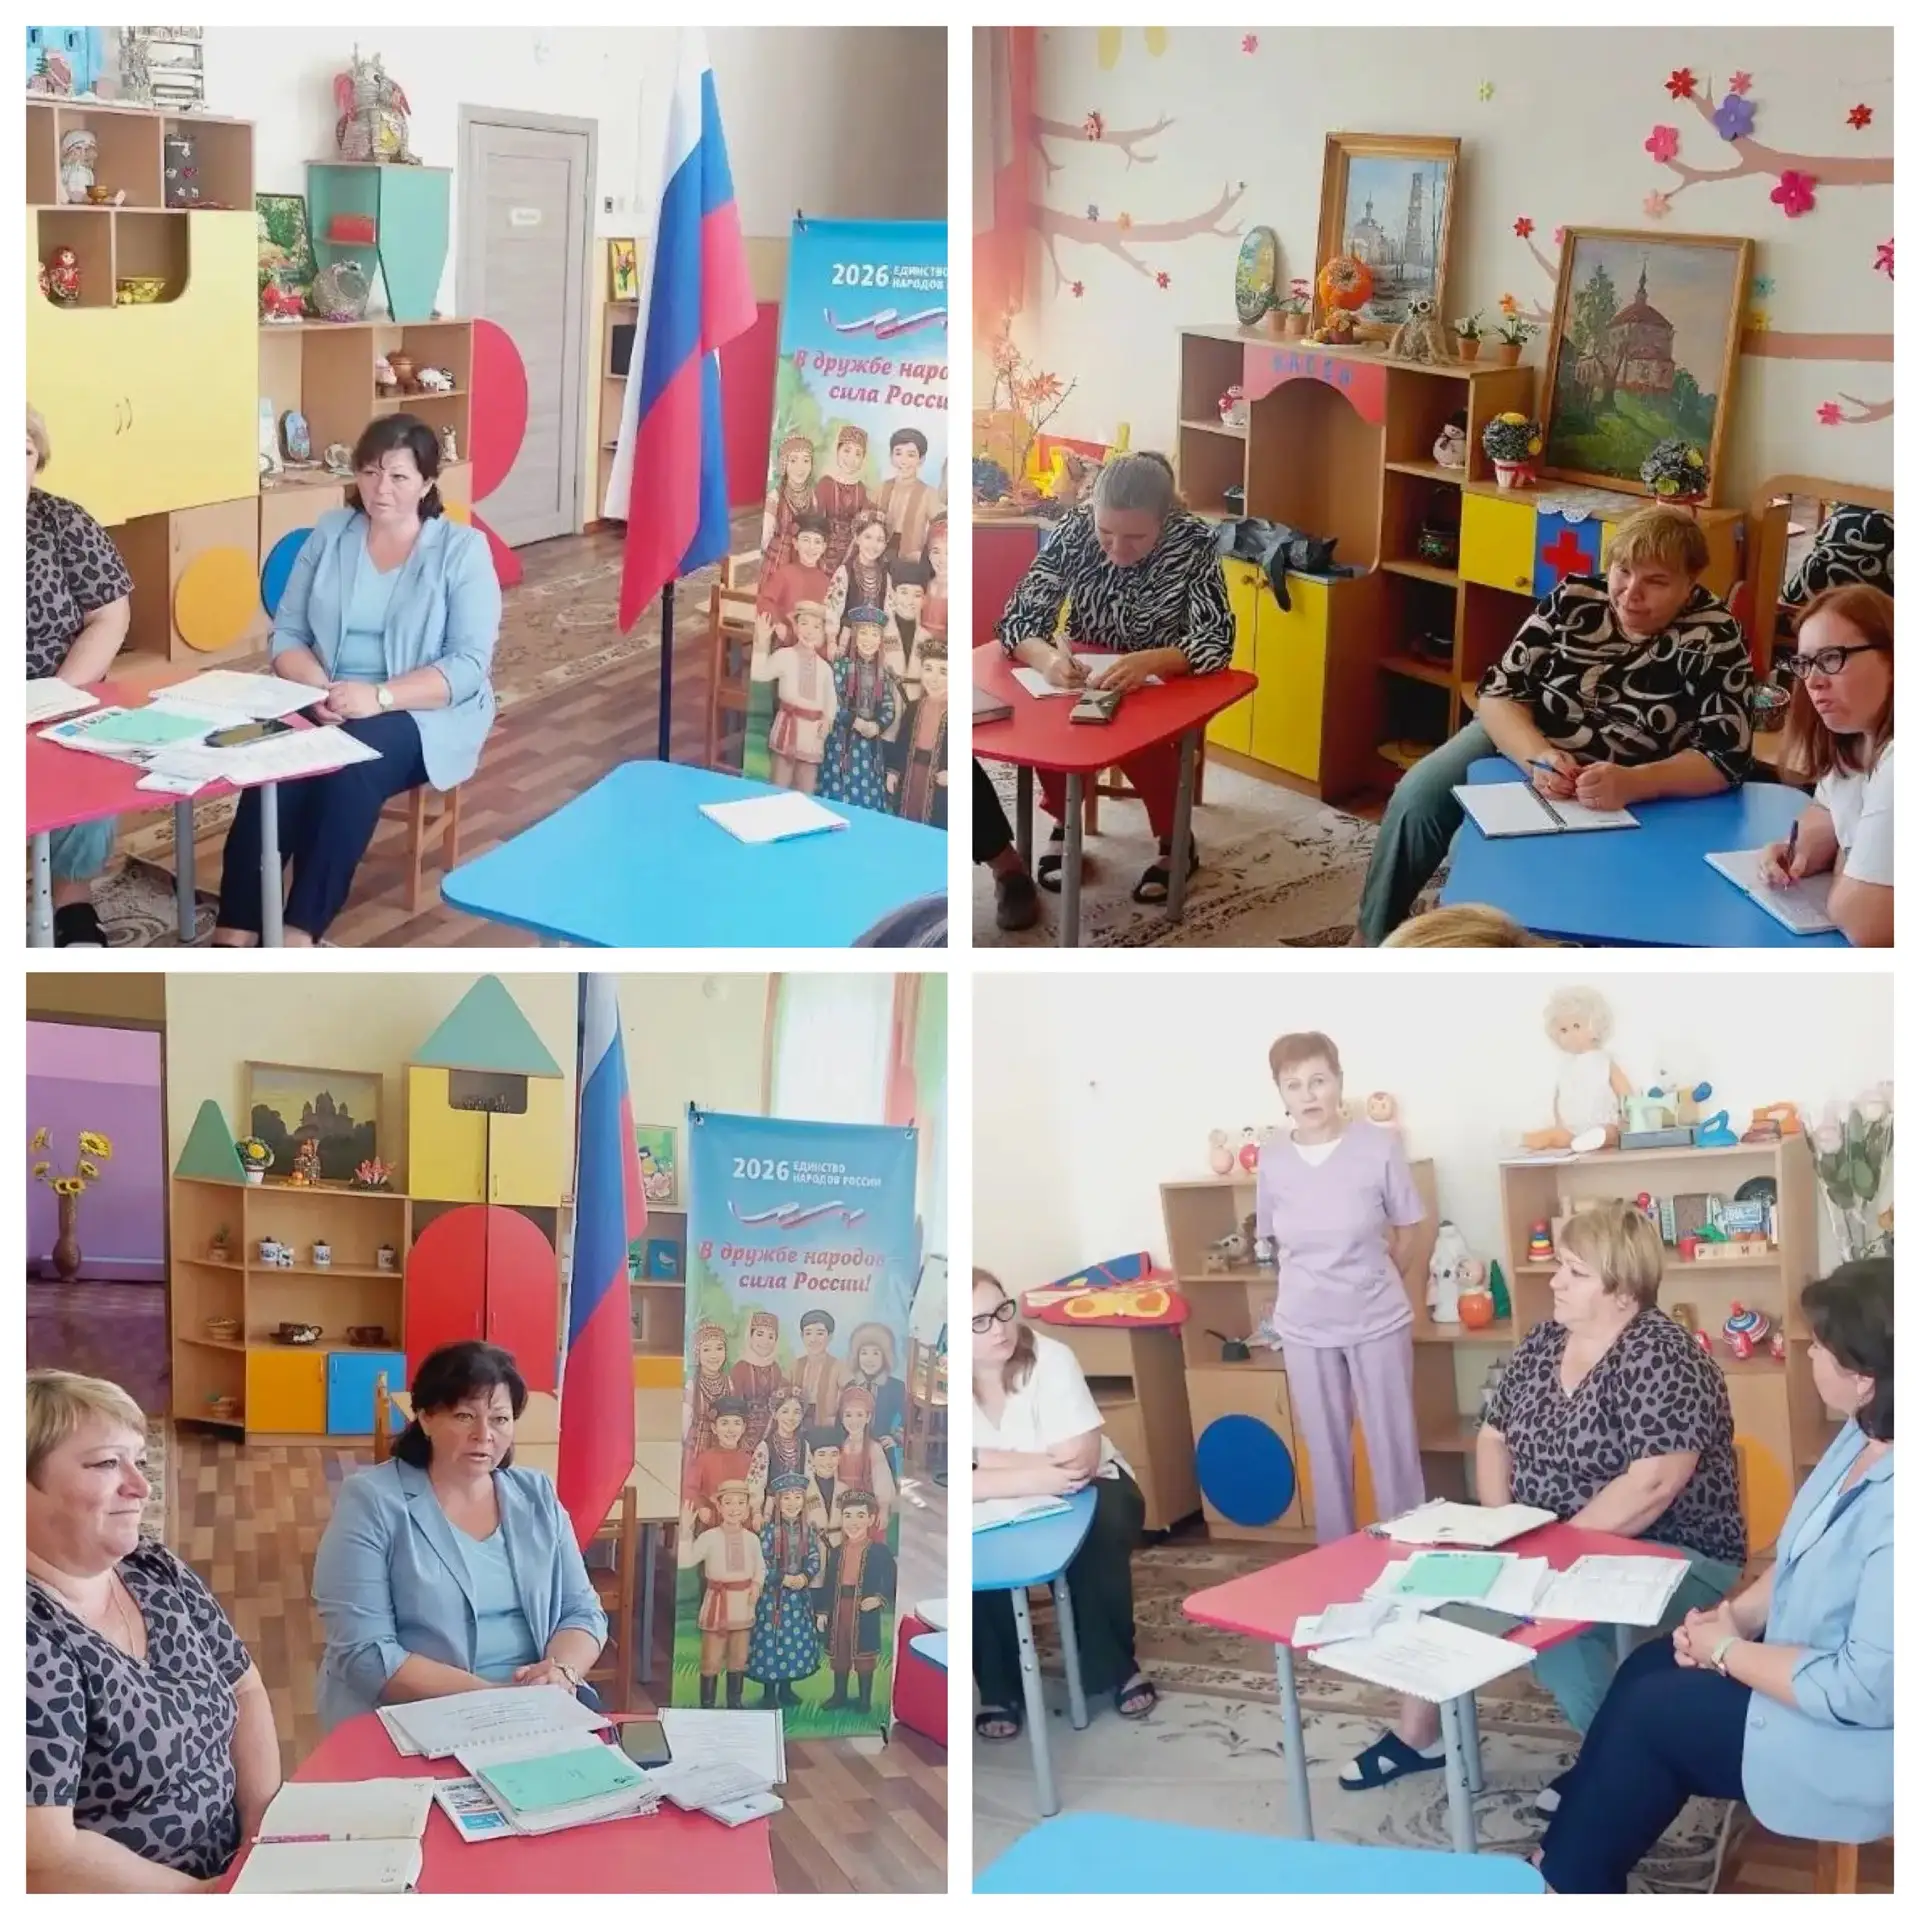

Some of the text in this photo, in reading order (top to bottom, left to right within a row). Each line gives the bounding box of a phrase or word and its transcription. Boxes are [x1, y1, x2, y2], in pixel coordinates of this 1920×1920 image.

[831, 263, 890, 288] 2026
[892, 278, 945, 292] НАРОДОВ
[795, 349, 808, 368] В
[813, 350, 892, 377] дружбе
[829, 384, 879, 403] сила
[732, 1157, 790, 1181] 2026
[793, 1161, 846, 1174] ЕДИНСТВО
[793, 1173, 882, 1188] НАРОДОВ РОССИИ
[698, 1241, 886, 1271] В дружбе народов
[739, 1272, 871, 1293] сила России!
